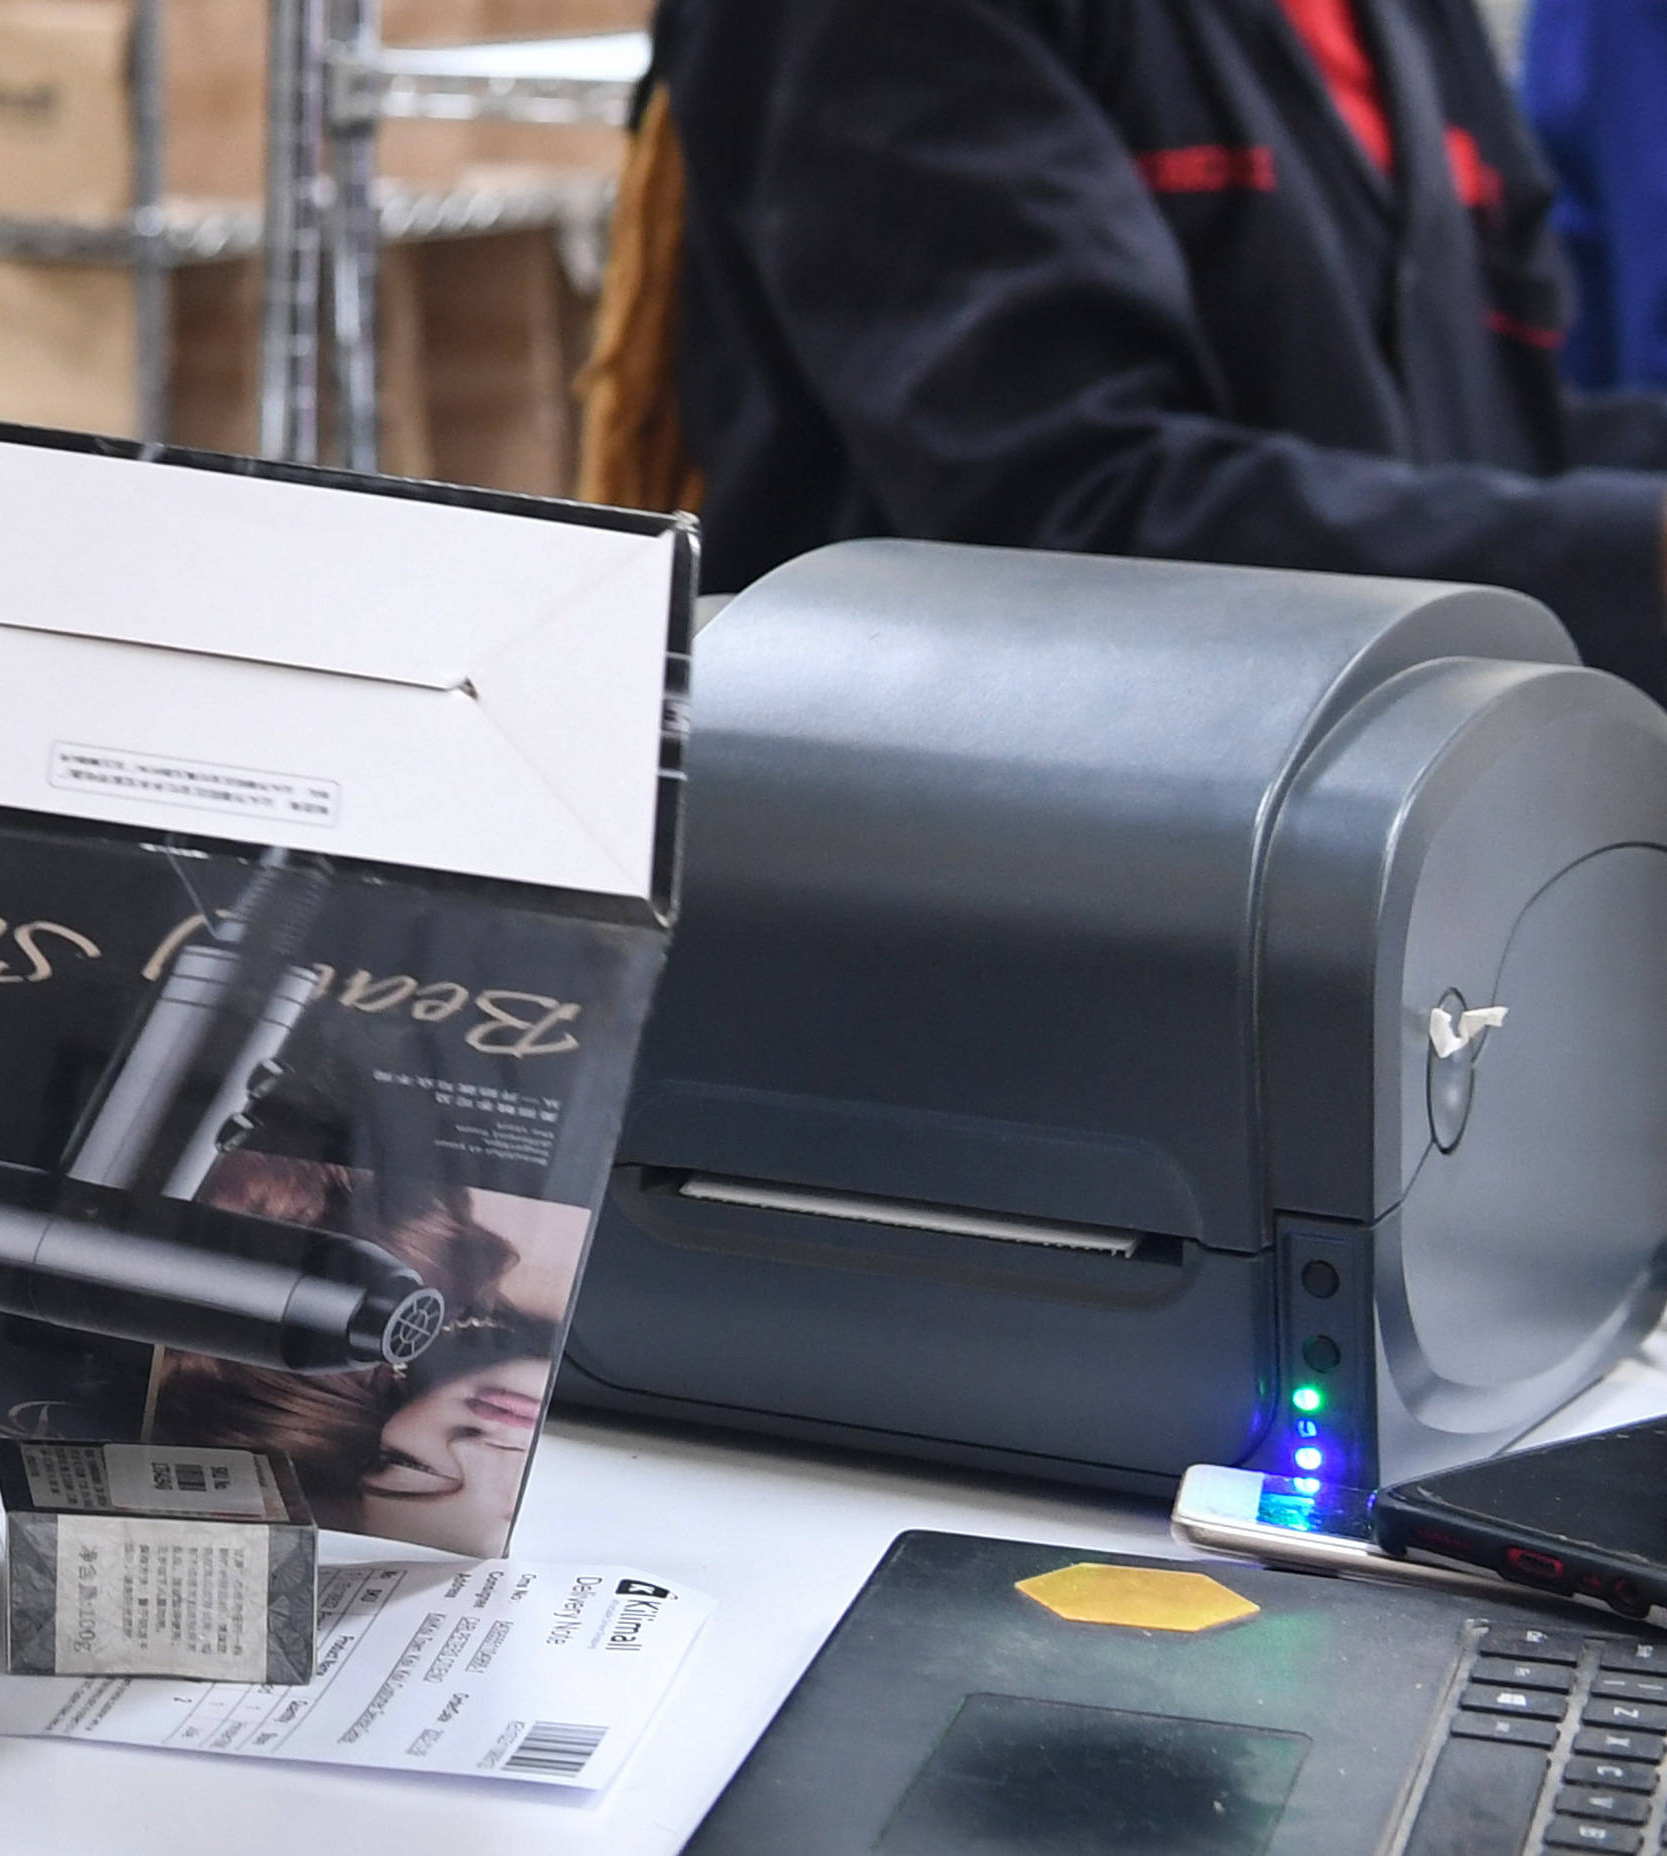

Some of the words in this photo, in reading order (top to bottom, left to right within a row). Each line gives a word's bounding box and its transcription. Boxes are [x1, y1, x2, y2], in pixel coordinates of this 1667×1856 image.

[554, 1576, 603, 1622] Delivery
[546, 1620, 582, 1646] Note
[605, 1599, 662, 1653] Kilimall
